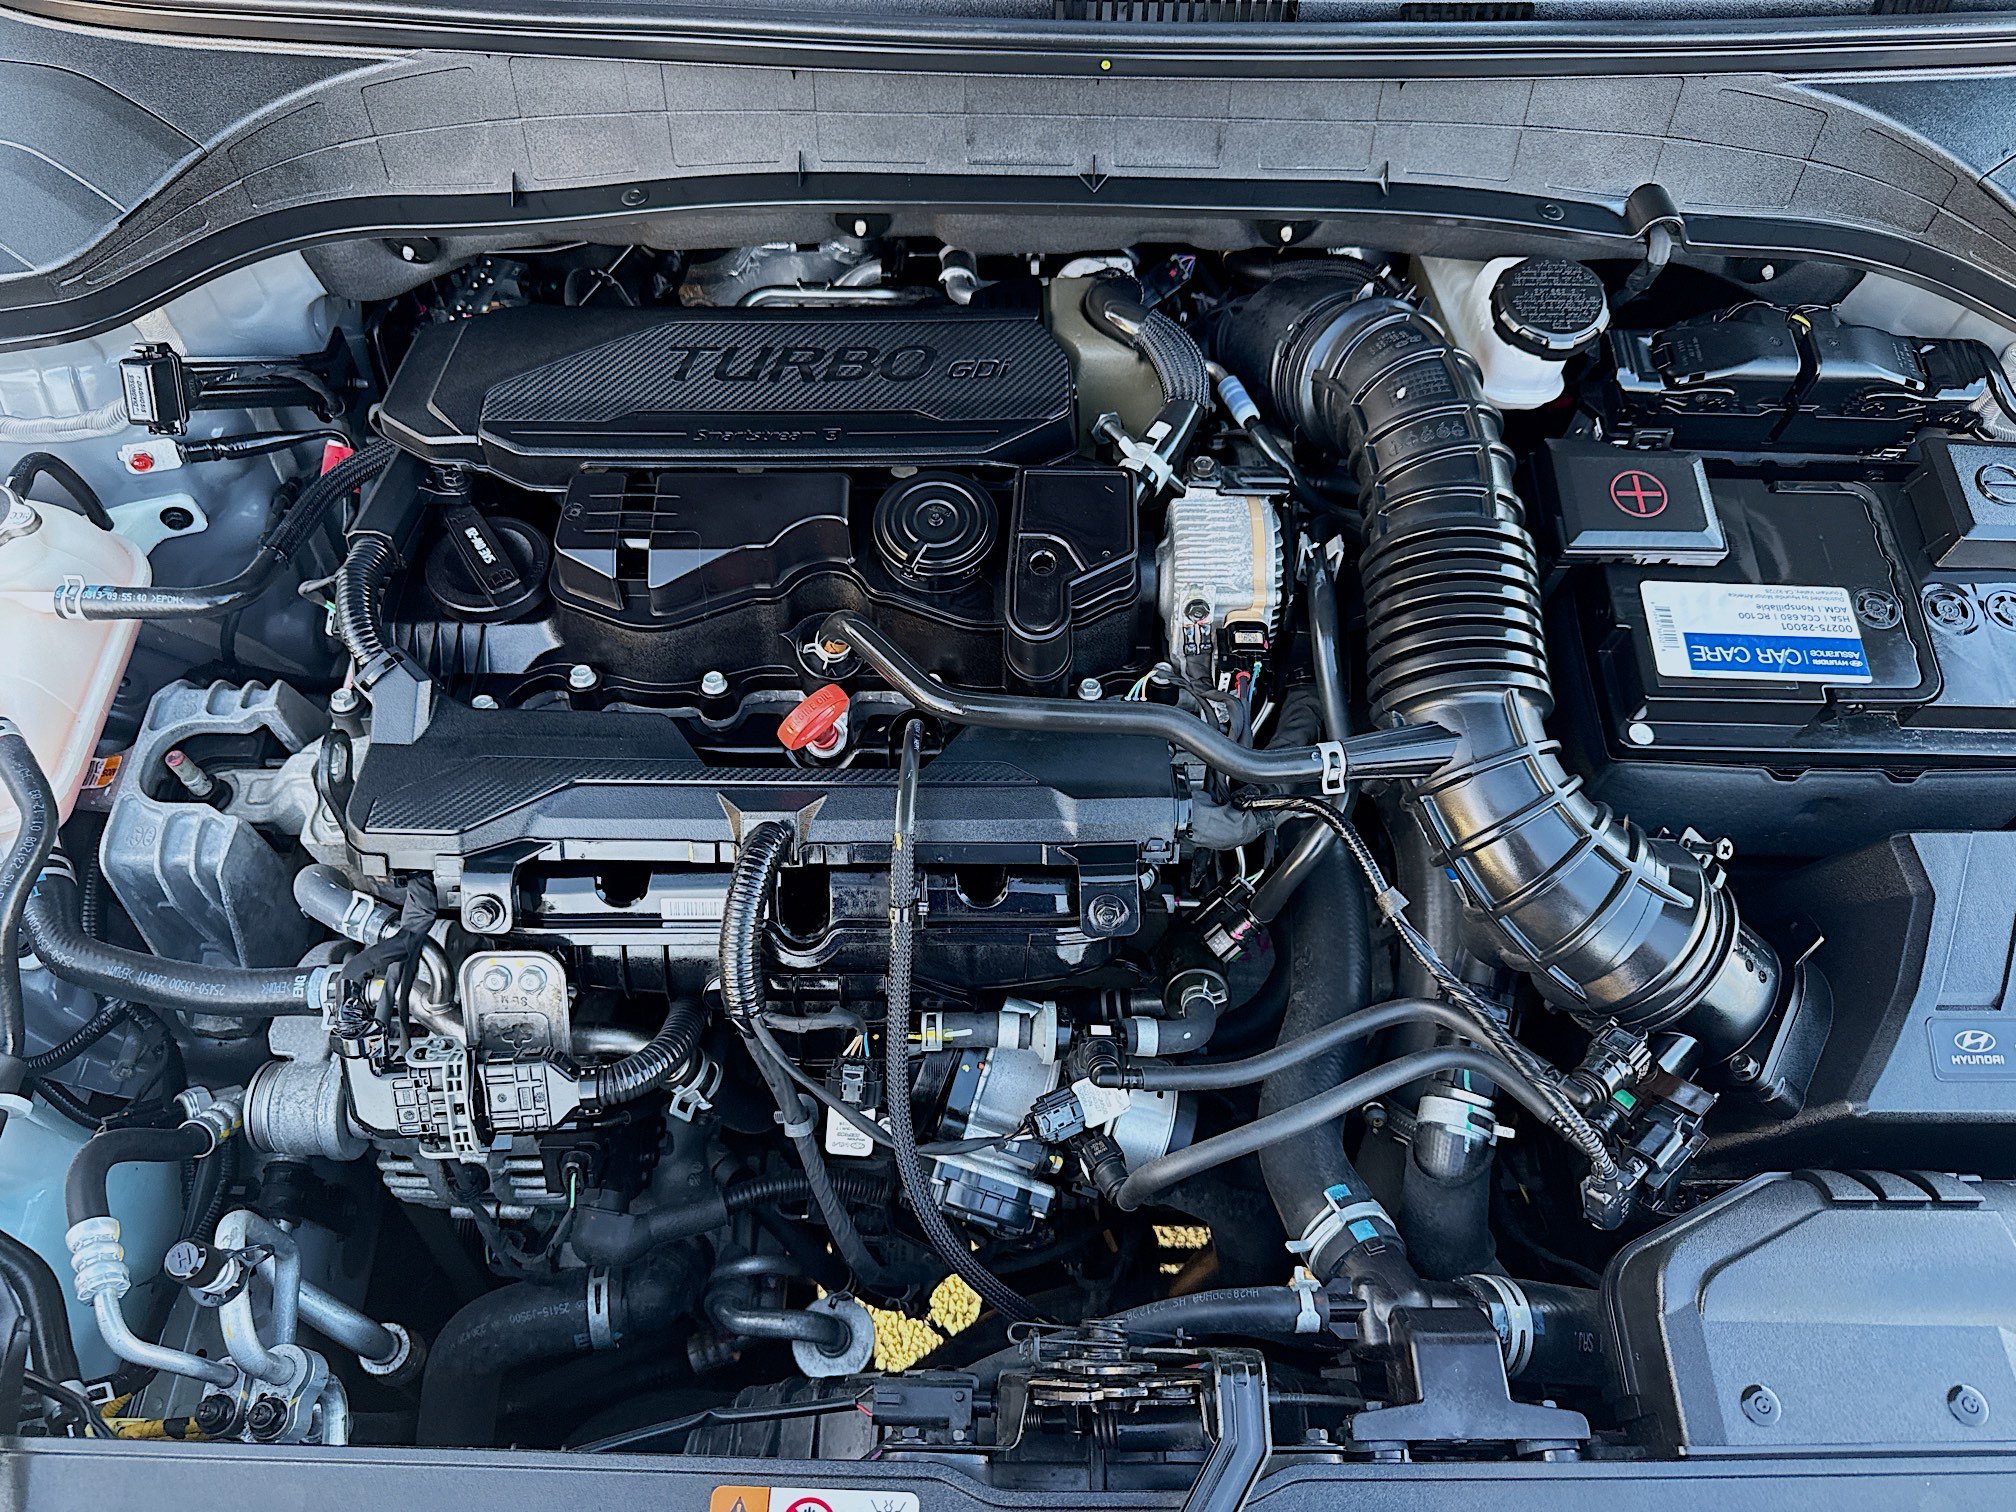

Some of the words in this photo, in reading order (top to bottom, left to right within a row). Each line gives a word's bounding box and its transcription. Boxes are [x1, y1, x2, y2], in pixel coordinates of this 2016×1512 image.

[669, 345, 938, 383] TURBO
[946, 357, 1013, 380] GDi
[693, 429, 817, 441] Smartstream
[1755, 603, 1815, 613] Nonspillable
[1780, 613, 1799, 621] 680
[1800, 614, 1821, 622] CCA
[1781, 622, 1853, 633] 00275-28001
[1690, 645, 1751, 663] CARE
[1755, 647, 1802, 665] CAR
[1809, 649, 1860, 660] Assurance
[1812, 658, 1849, 666] HYUNDAI
[816, 692, 833, 706] OIL
[169, 978, 226, 997] 25450-J9500
[1951, 1054, 2005, 1065] HYUNDAI
